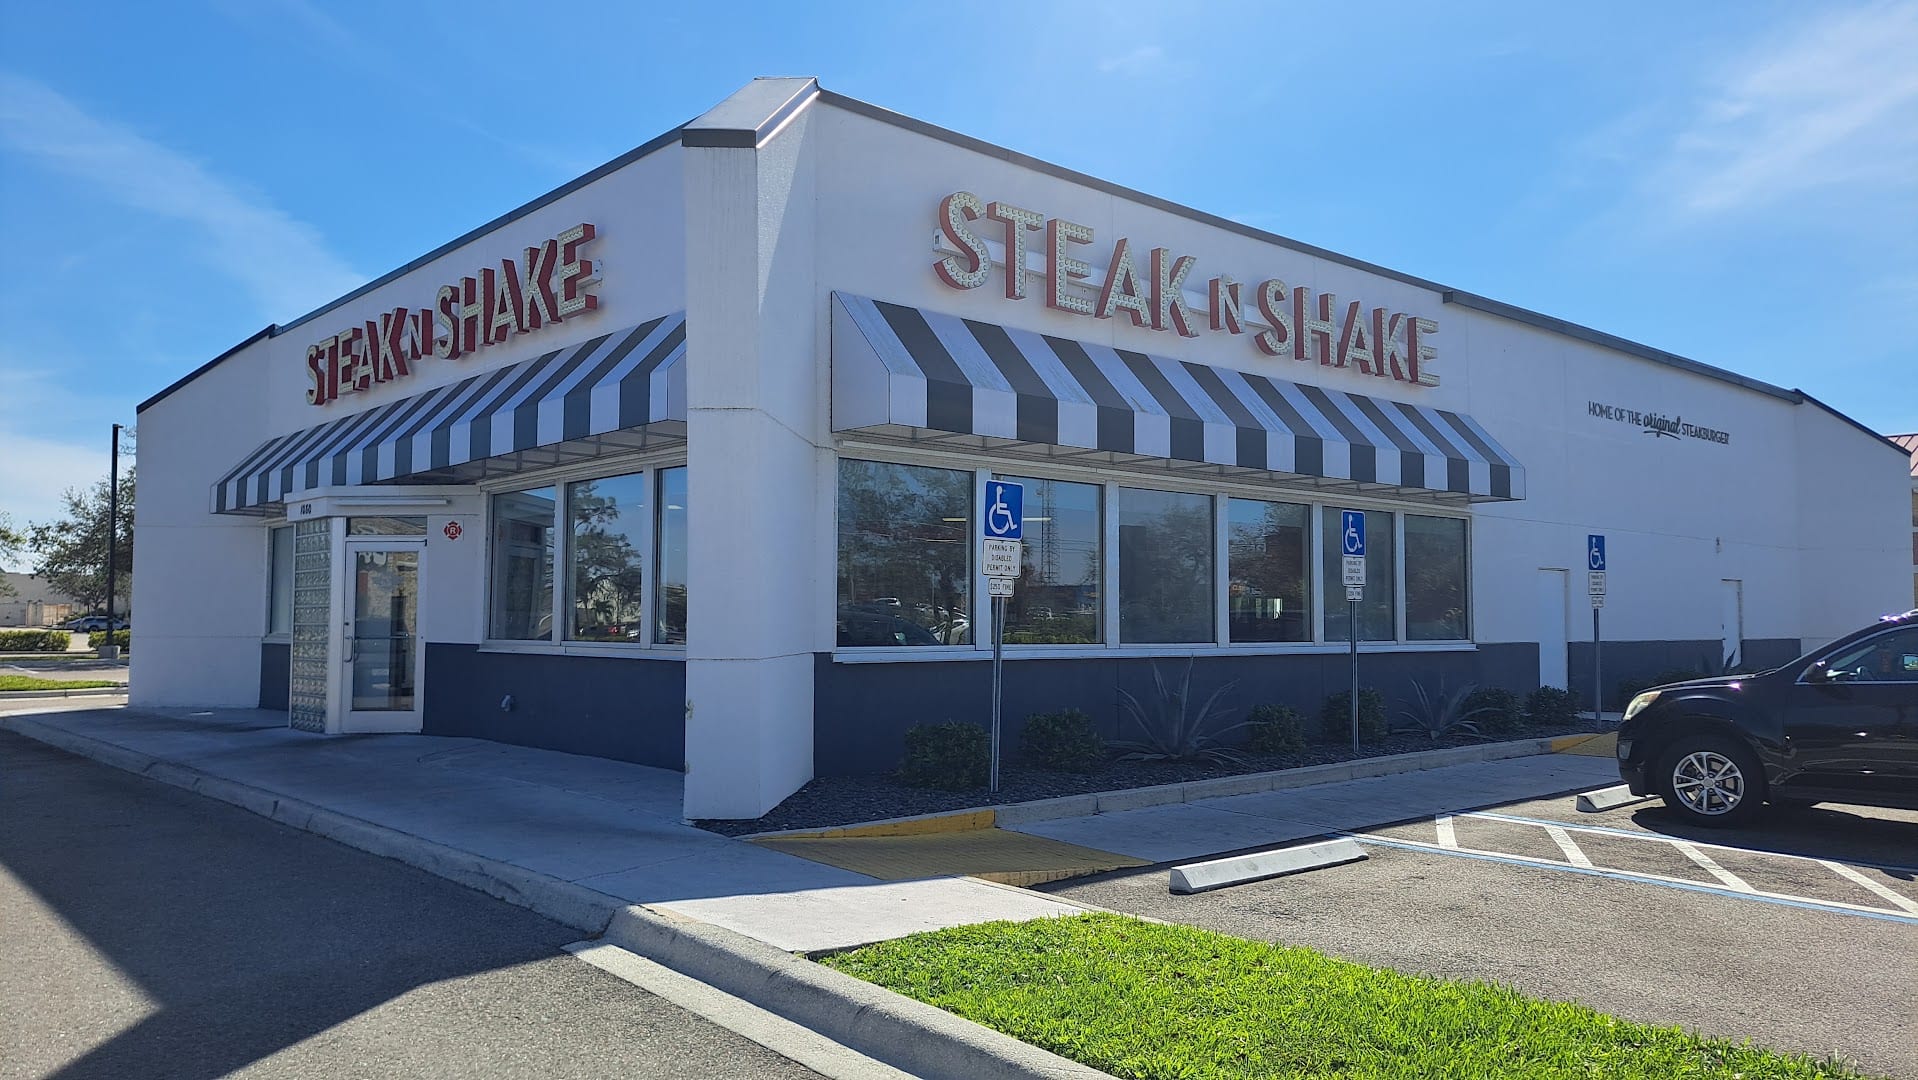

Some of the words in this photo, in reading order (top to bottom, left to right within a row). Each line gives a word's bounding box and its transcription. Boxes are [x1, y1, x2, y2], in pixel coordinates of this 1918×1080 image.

[306, 307, 409, 405] STEAK
[408, 308, 433, 360] N
[435, 222, 598, 361] SHAKE
[933, 191, 1199, 338] STEAK
[1209, 275, 1245, 334] N
[1255, 278, 1440, 387] SHAKE
[1588, 400, 1613, 420] HOME
[1614, 407, 1625, 422] OF
[1626, 410, 1642, 426] THE
[1643, 412, 1681, 439] original
[1681, 422, 1730, 445] STEAKBURGER
[986, 563, 1003, 571] PERMIT
[1004, 564, 1016, 572] ONLY
